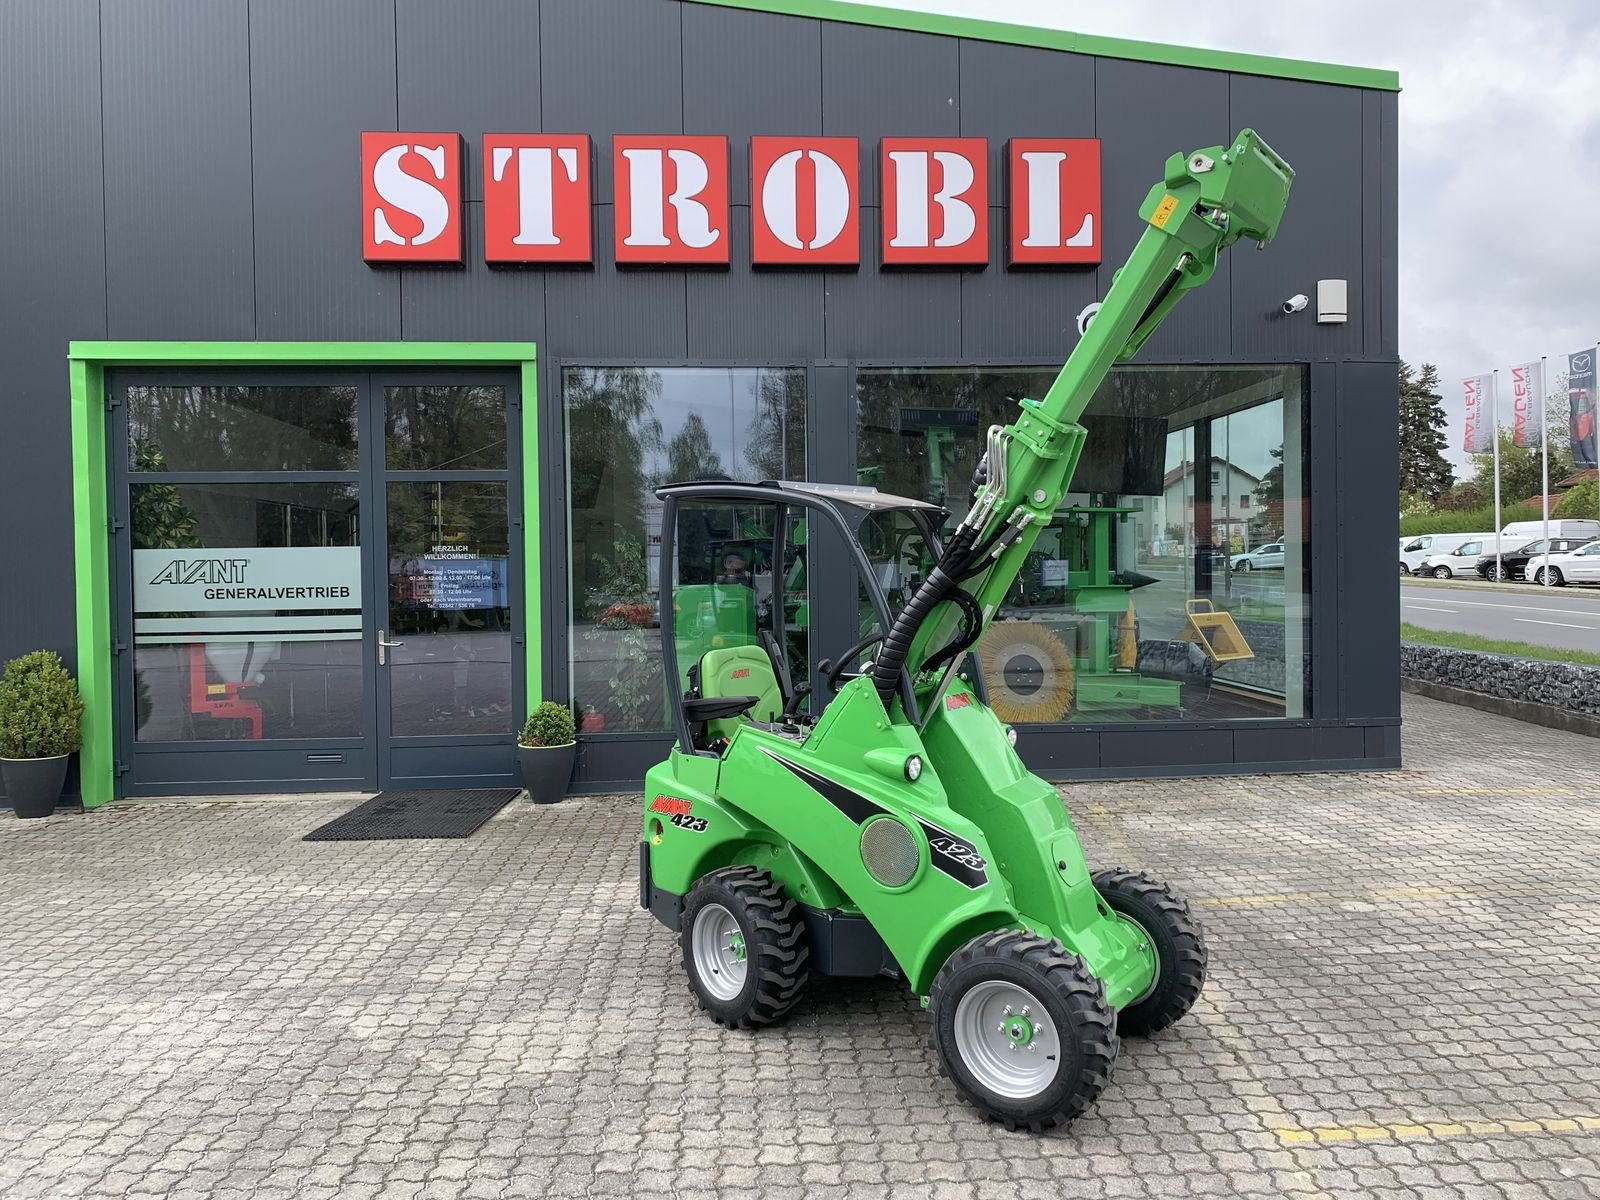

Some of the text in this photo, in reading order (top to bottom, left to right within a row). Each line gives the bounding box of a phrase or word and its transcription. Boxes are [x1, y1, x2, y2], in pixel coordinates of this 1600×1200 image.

[373, 144, 1094, 251] STROBL
[149, 559, 248, 584] AVANT
[204, 586, 350, 600] GENERALVERTRIEB
[648, 794, 692, 816] AVANT
[670, 813, 708, 832] 423
[930, 837, 987, 870] 423
